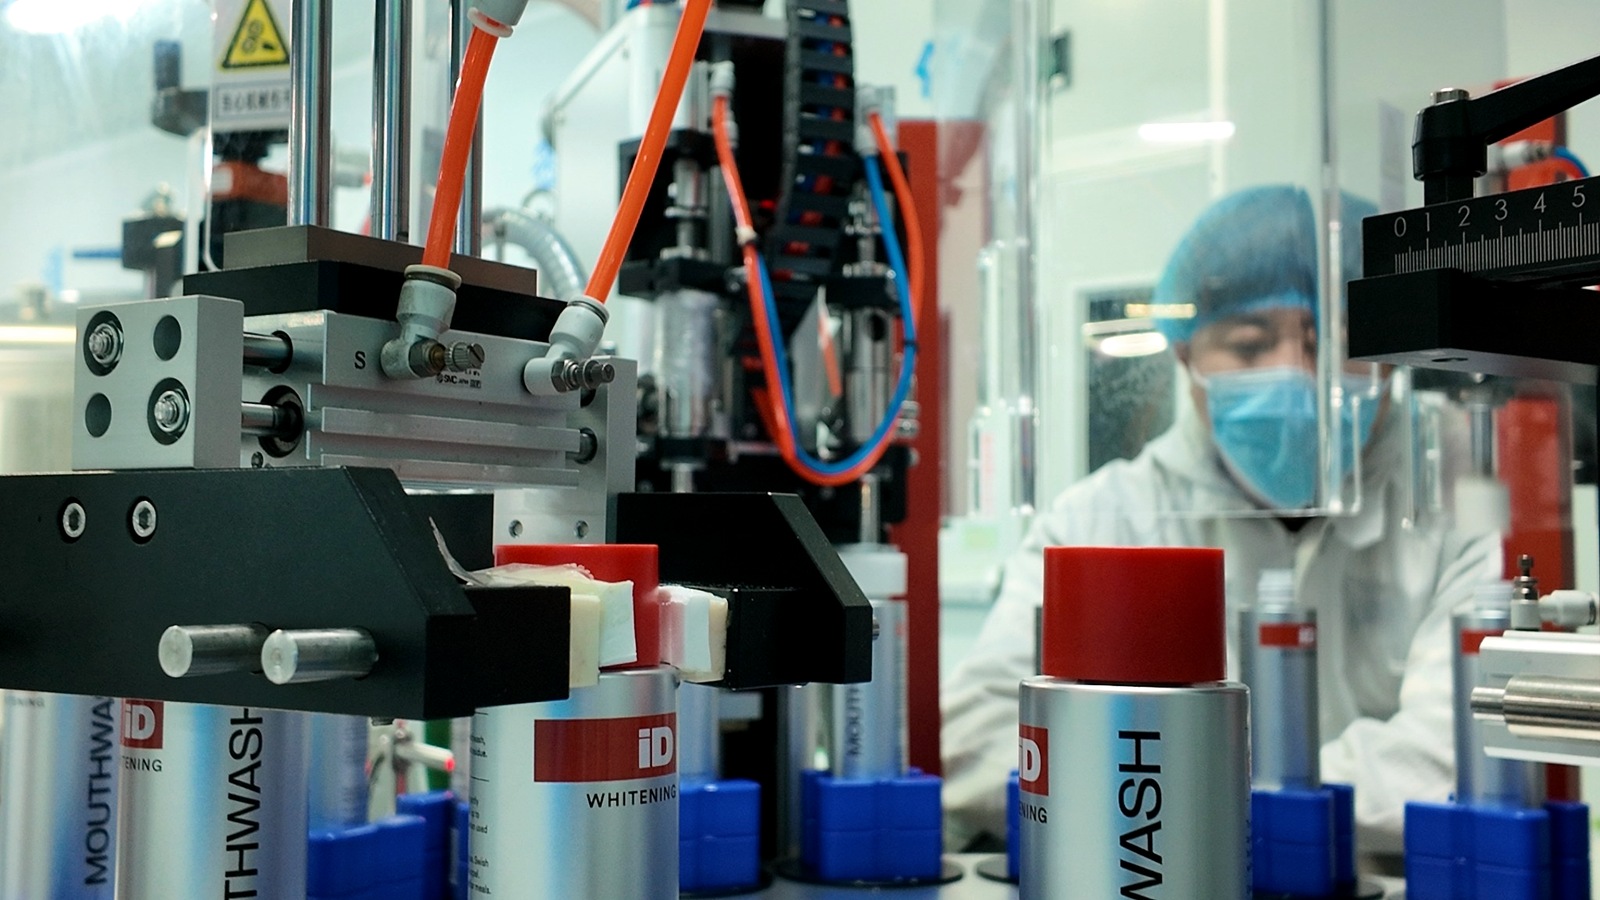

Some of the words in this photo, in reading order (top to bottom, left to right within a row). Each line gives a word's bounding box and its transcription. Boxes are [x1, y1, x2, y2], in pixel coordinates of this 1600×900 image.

[1394, 216, 1407, 237] 0
[1425, 212, 1431, 232] 1
[1458, 205, 1471, 227] 2
[1494, 199, 1509, 221] 3
[1533, 192, 1547, 213] 4
[1571, 185, 1586, 208] 5
[354, 350, 366, 370] S
[122, 756, 163, 772] ENING
[638, 725, 674, 769] iD
[84, 697, 115, 887] MOUTHWA
[586, 784, 677, 809] WHITENING
